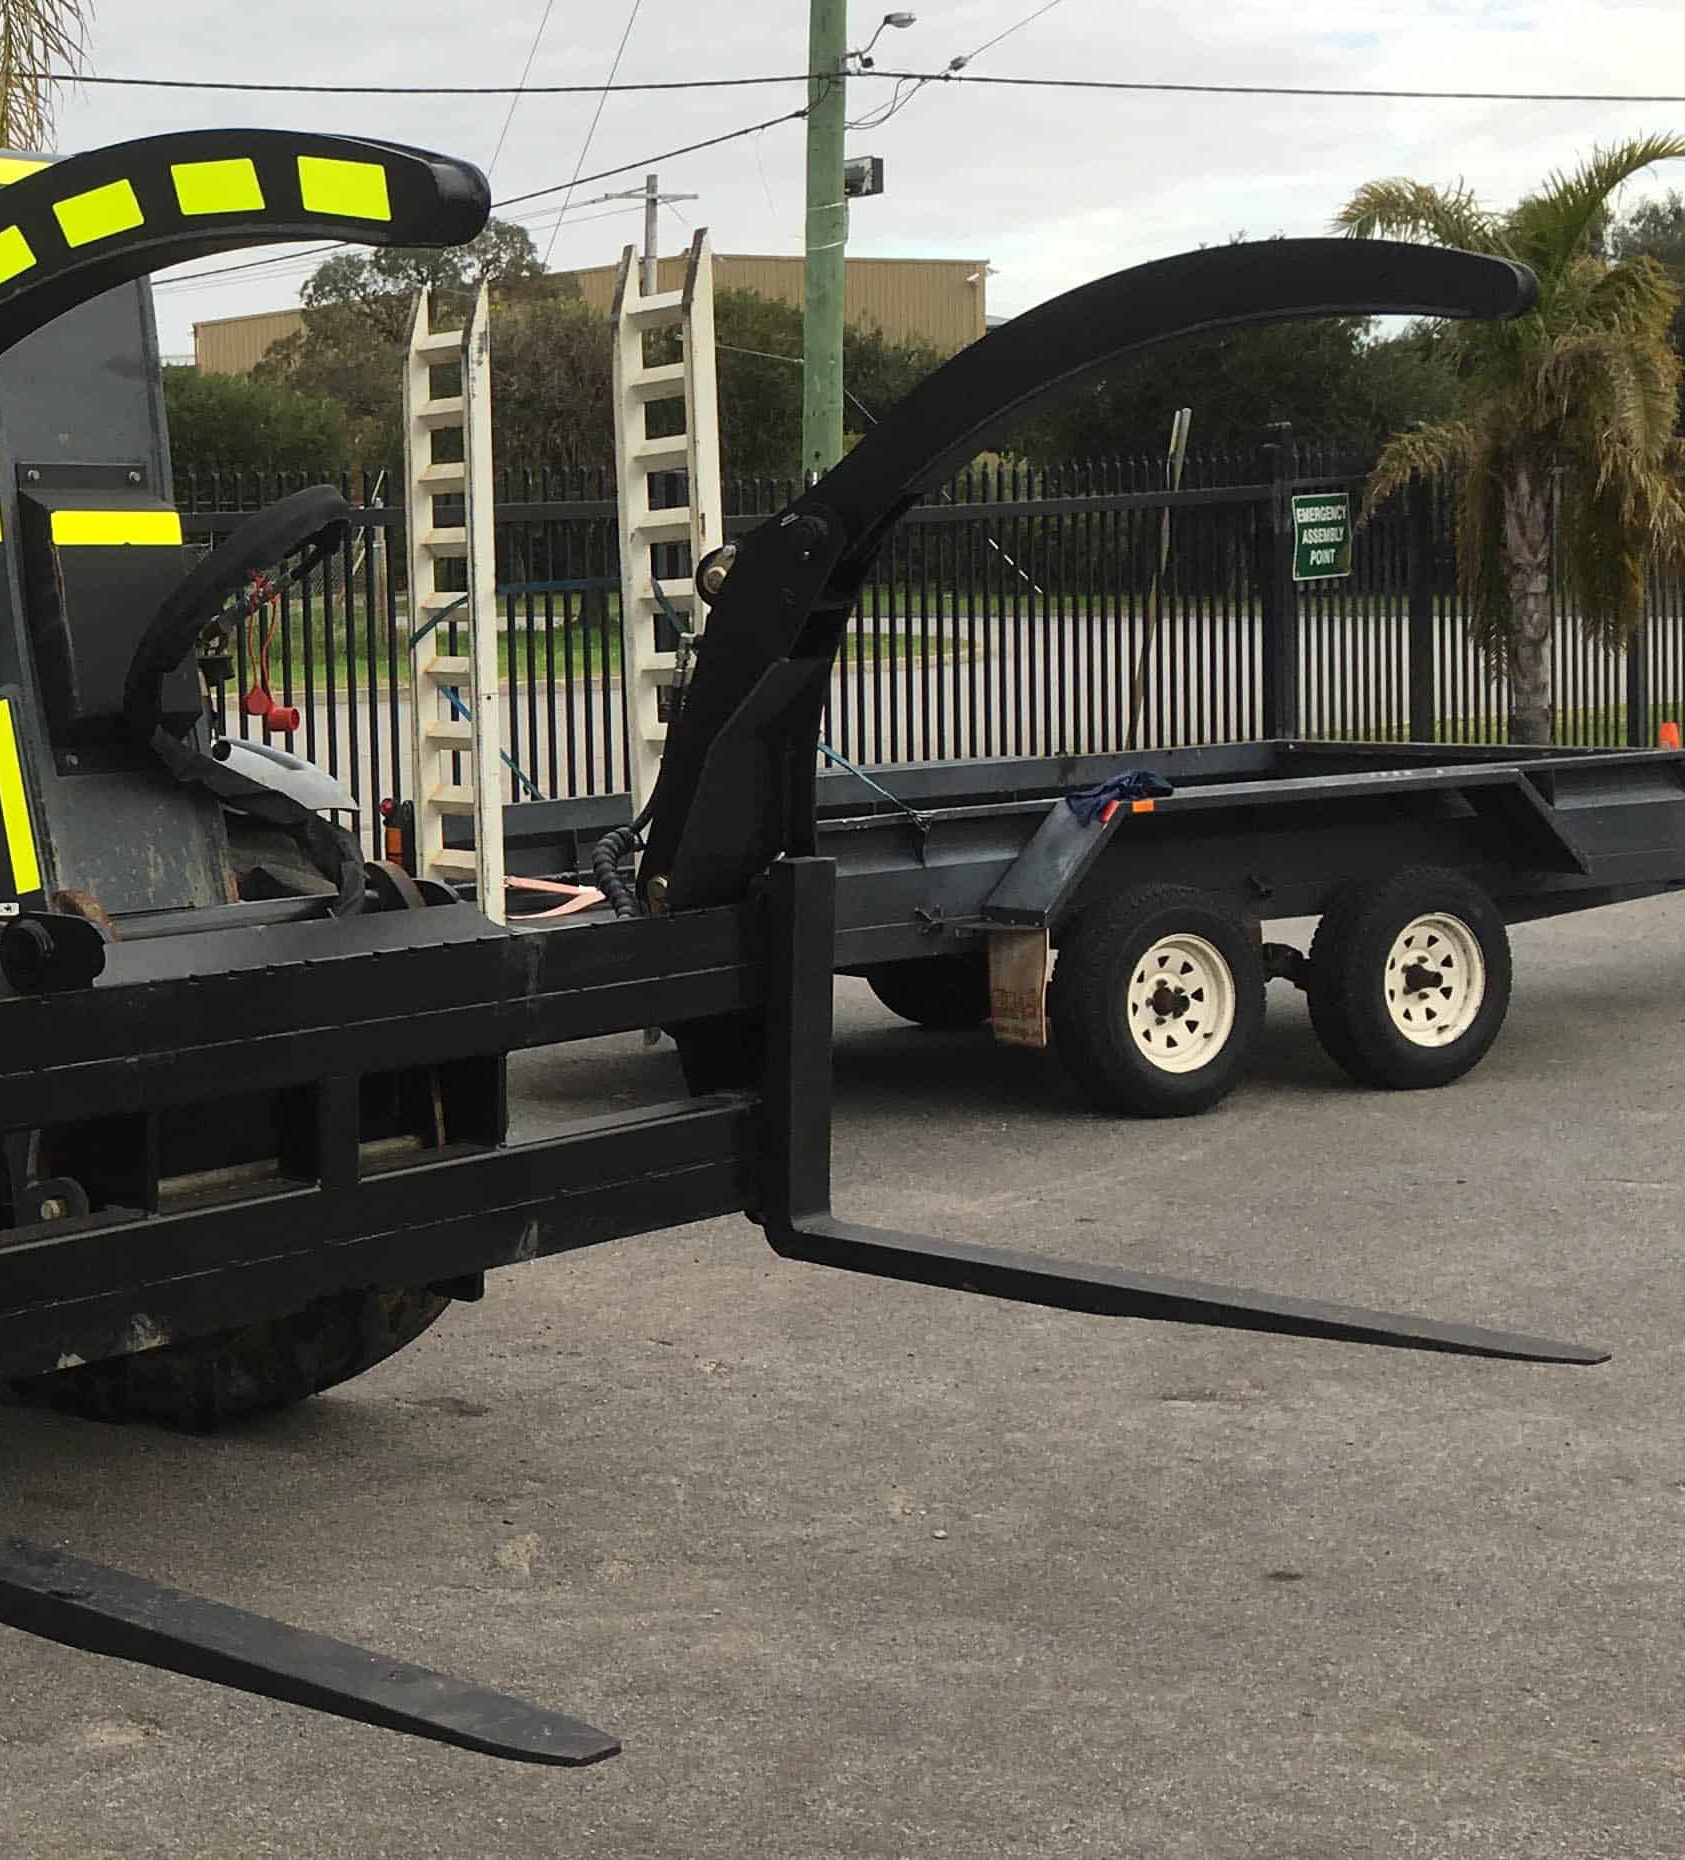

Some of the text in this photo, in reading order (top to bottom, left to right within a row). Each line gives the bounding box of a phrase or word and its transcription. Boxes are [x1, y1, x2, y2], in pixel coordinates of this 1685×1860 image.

[1296, 505, 1347, 523] EMERGENCY
[1302, 527, 1345, 544] ASSEMBLY
[1309, 548, 1336, 566] POINT
